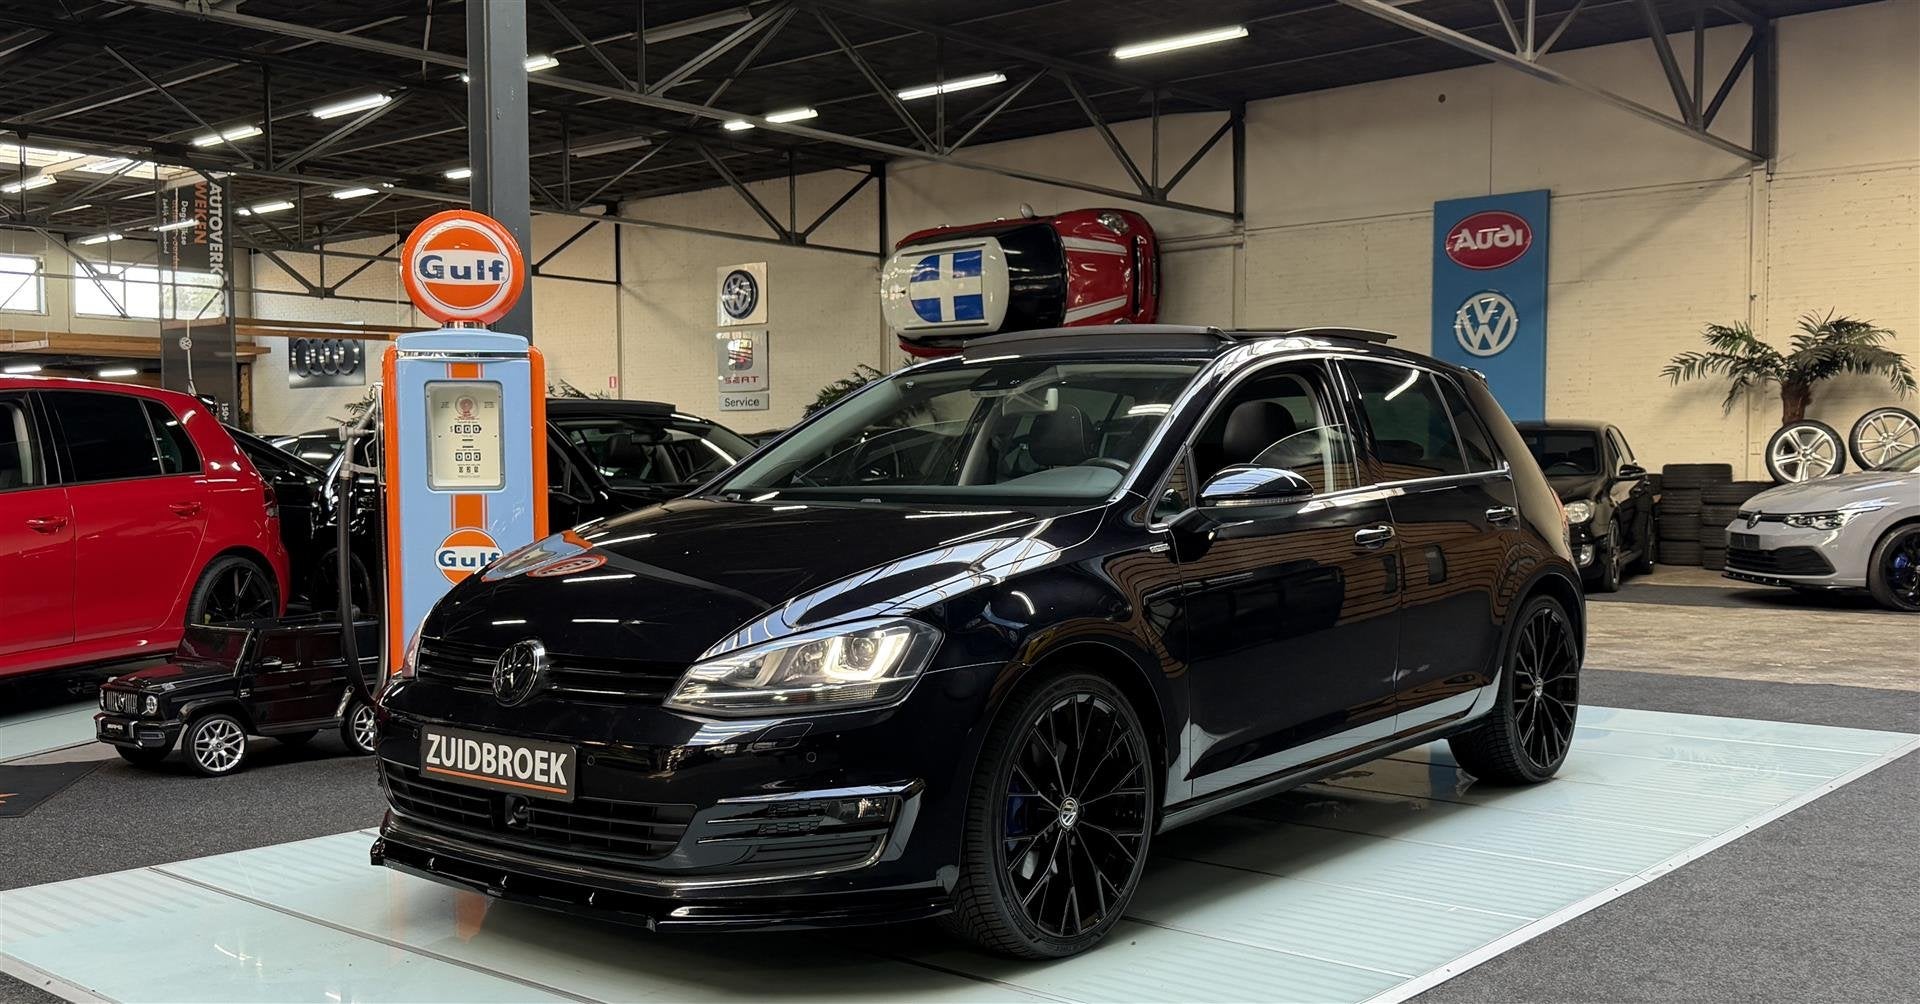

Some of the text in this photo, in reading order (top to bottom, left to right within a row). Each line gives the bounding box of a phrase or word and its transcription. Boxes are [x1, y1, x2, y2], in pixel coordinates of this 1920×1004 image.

[194, 181, 208, 245] WEKEN
[1453, 224, 1524, 252] Audi
[419, 254, 505, 281] Gulf
[725, 375, 760, 384] SEAT
[724, 397, 760, 408] Service
[426, 733, 568, 786] ZUIDBROEK
